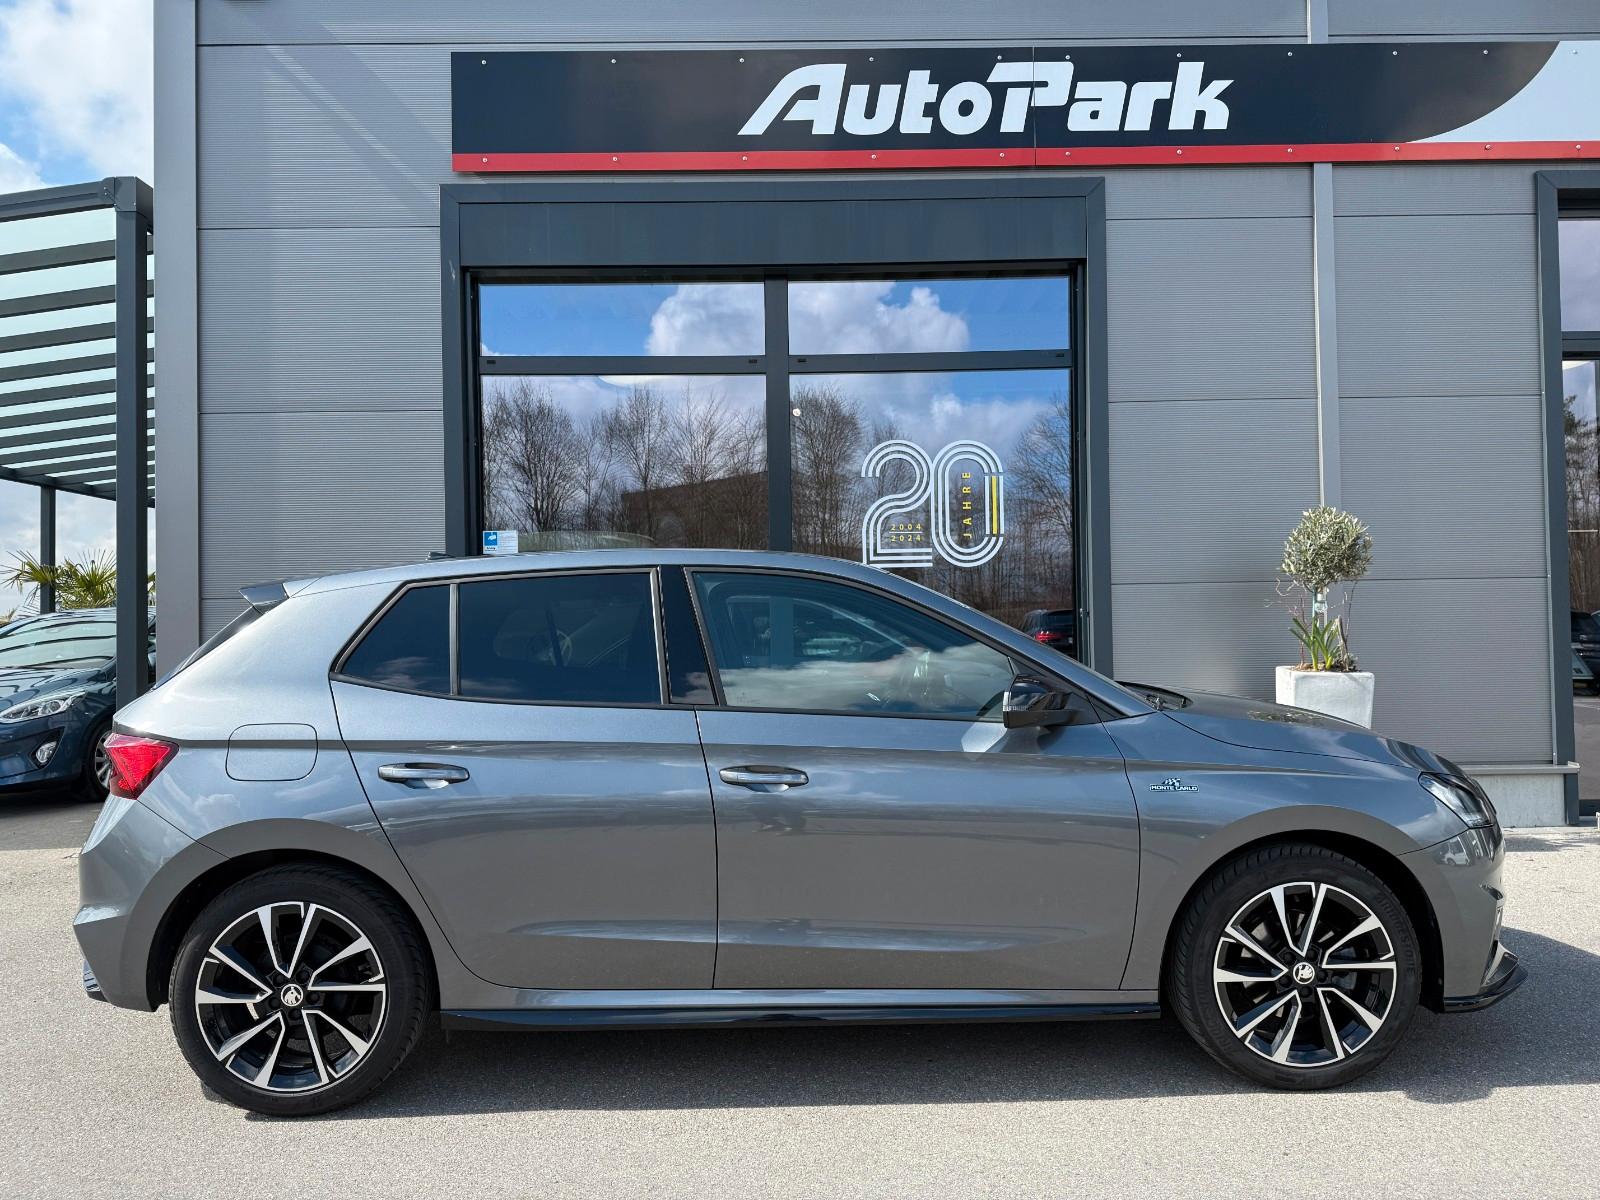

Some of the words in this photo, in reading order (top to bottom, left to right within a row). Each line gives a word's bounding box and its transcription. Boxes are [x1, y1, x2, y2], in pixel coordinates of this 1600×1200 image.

[737, 61, 1234, 136] AutoPark
[861, 439, 1005, 568] 20
[890, 523, 922, 531] 2004
[961, 471, 972, 539] JAHRE
